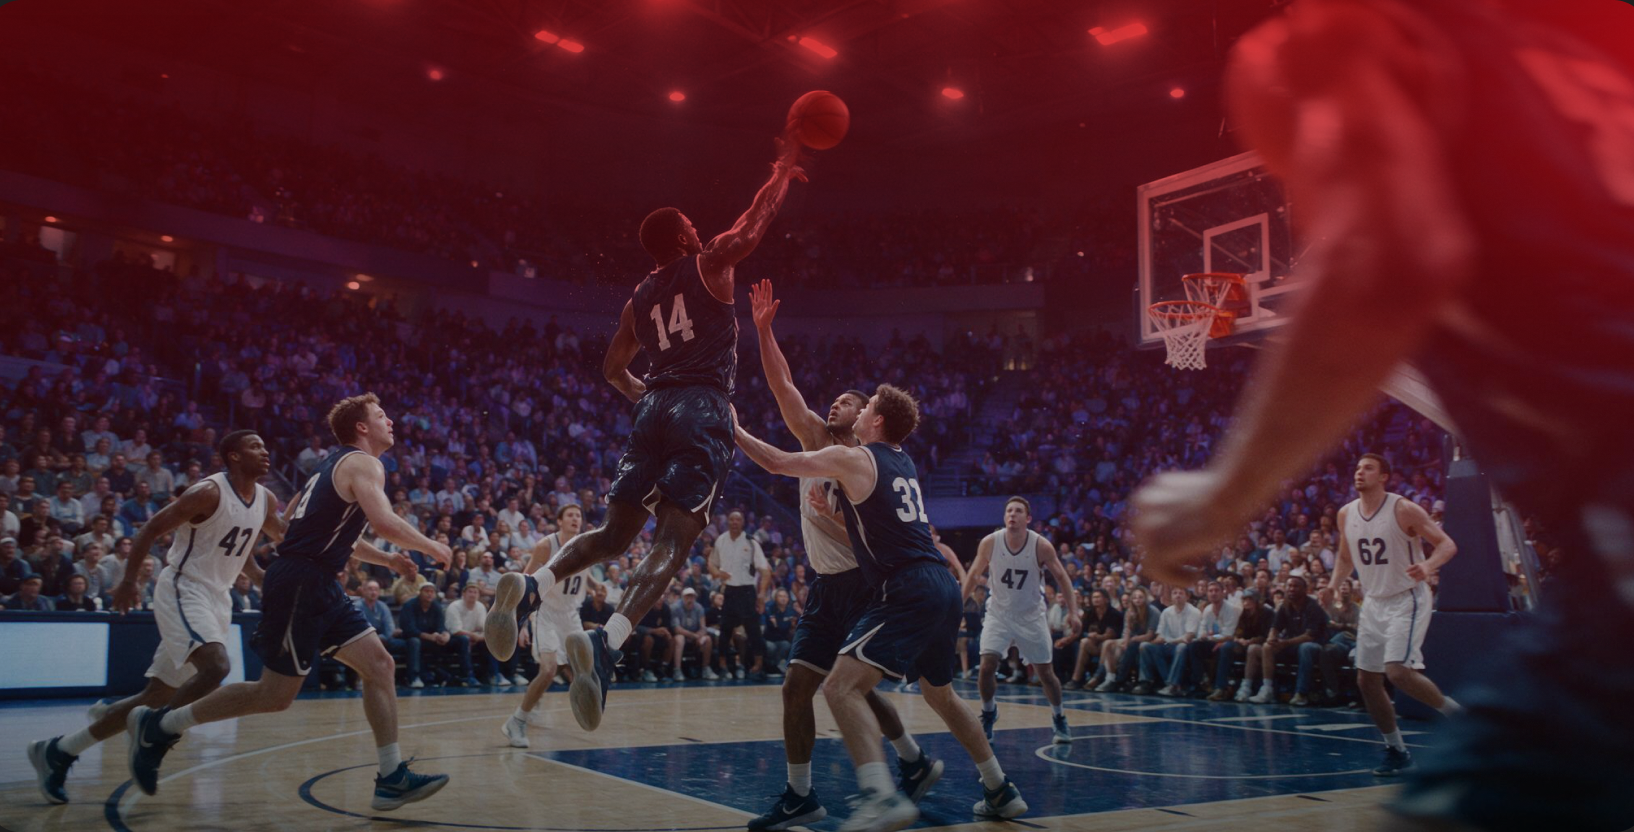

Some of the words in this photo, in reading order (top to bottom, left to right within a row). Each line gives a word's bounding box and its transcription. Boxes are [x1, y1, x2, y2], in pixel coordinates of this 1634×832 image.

[650, 293, 695, 351] 14
[218, 526, 253, 556] 47
[1358, 537, 1388, 565] 62
[1001, 568, 1028, 590] 47
